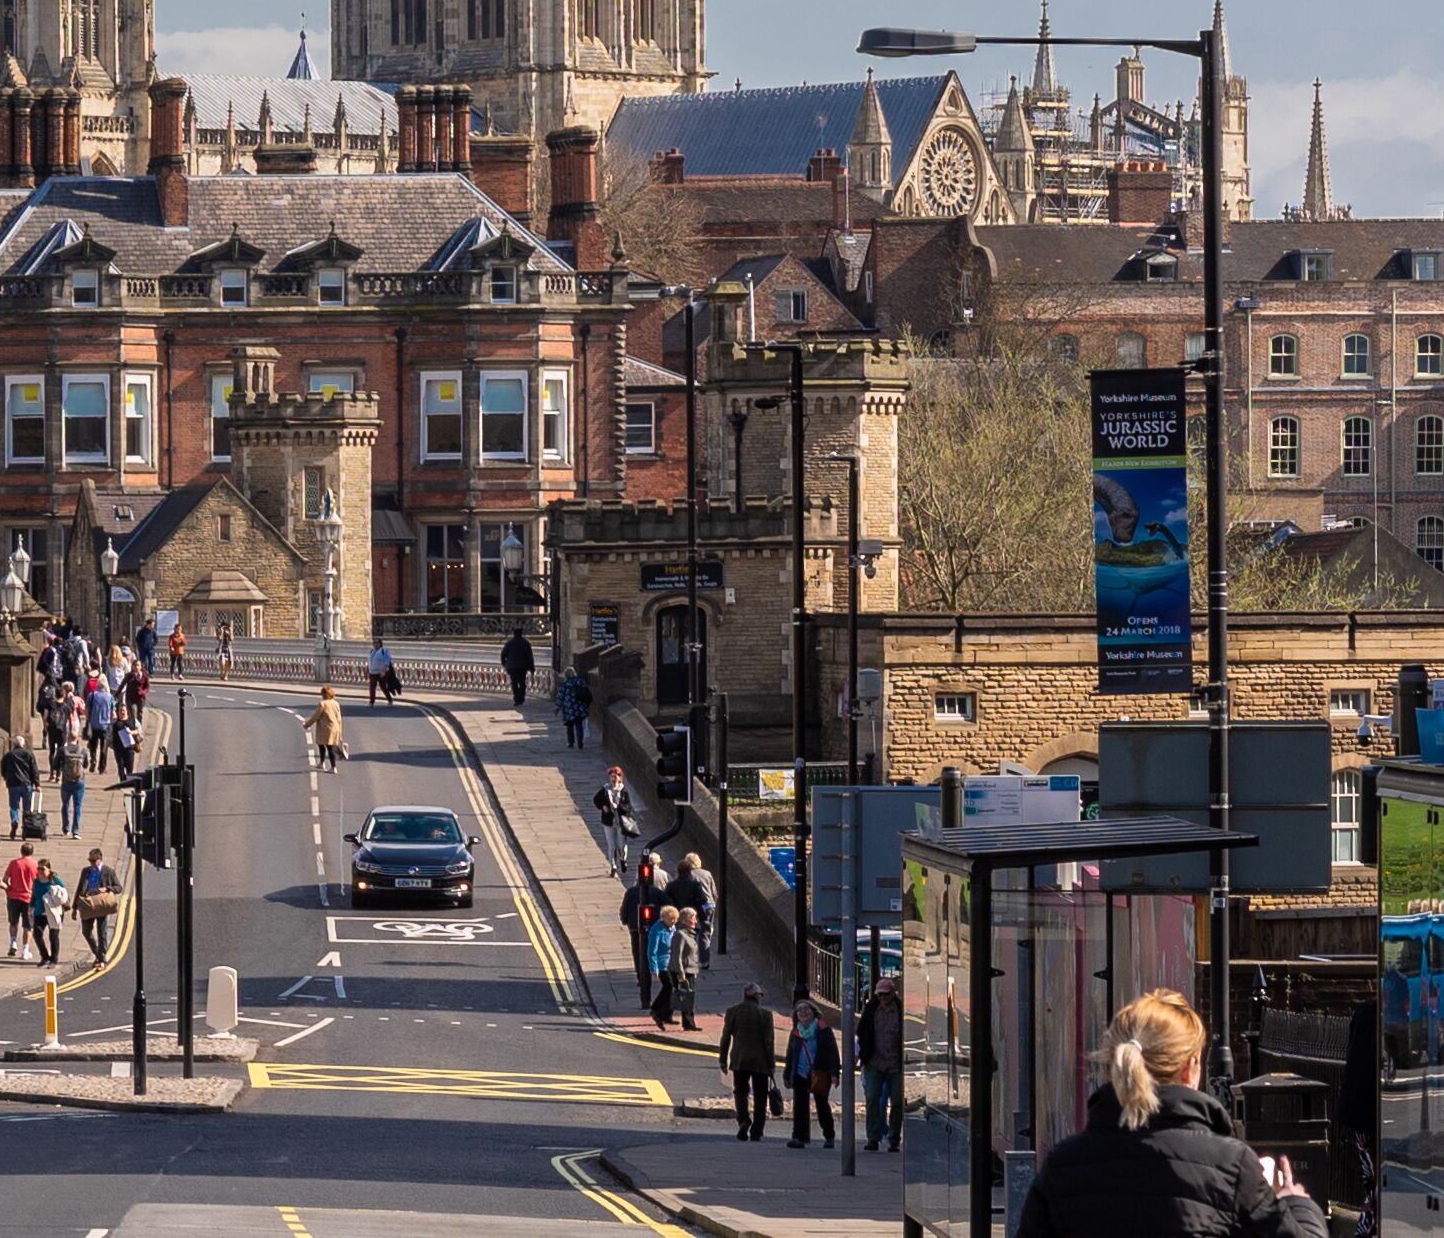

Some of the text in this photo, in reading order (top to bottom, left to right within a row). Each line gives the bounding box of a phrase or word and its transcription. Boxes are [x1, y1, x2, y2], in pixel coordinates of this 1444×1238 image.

[1100, 394, 1177, 403] Yorkshire Museum
[1100, 411, 1177, 421] YORKSHIRE'S
[1100, 421, 1176, 435] JURASSIC
[1108, 435, 1168, 448] WORLD
[1106, 627, 1119, 636] 24
[1159, 625, 1181, 634] 2018
[1106, 650, 1183, 660] Yorkshire Museum
